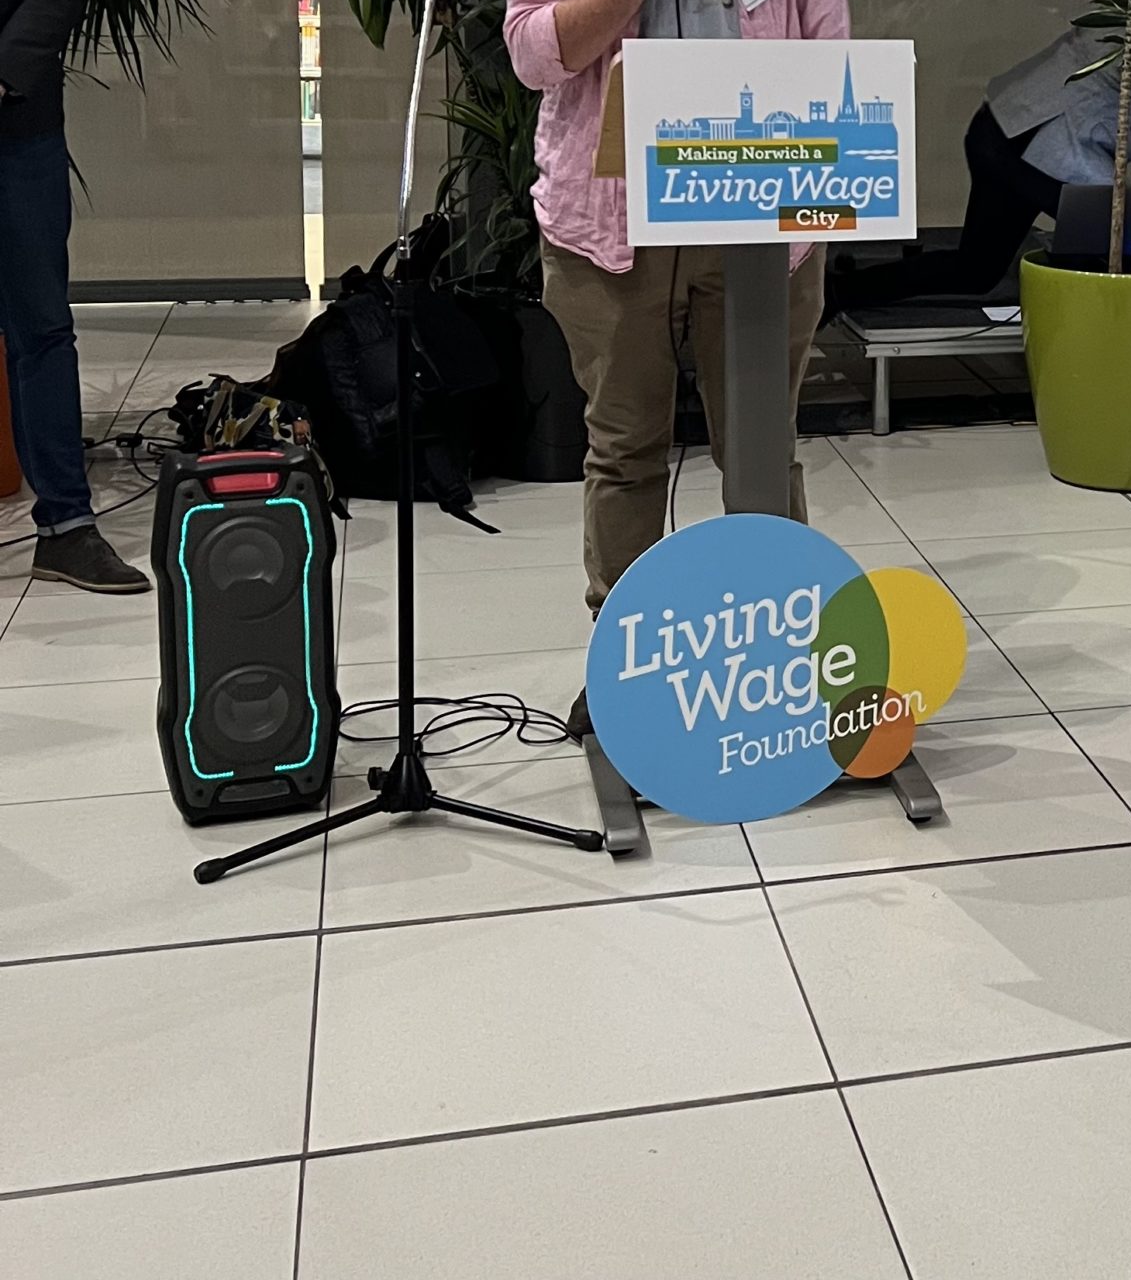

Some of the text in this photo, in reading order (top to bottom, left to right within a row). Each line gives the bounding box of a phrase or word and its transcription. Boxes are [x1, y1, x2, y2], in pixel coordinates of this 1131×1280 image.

[677, 145, 823, 163] Making Norwich a
[660, 166, 895, 211] Living Wage
[795, 208, 841, 230] City
[618, 584, 822, 681] Living
[666, 643, 857, 732] Wage
[718, 689, 927, 775] Foundation
